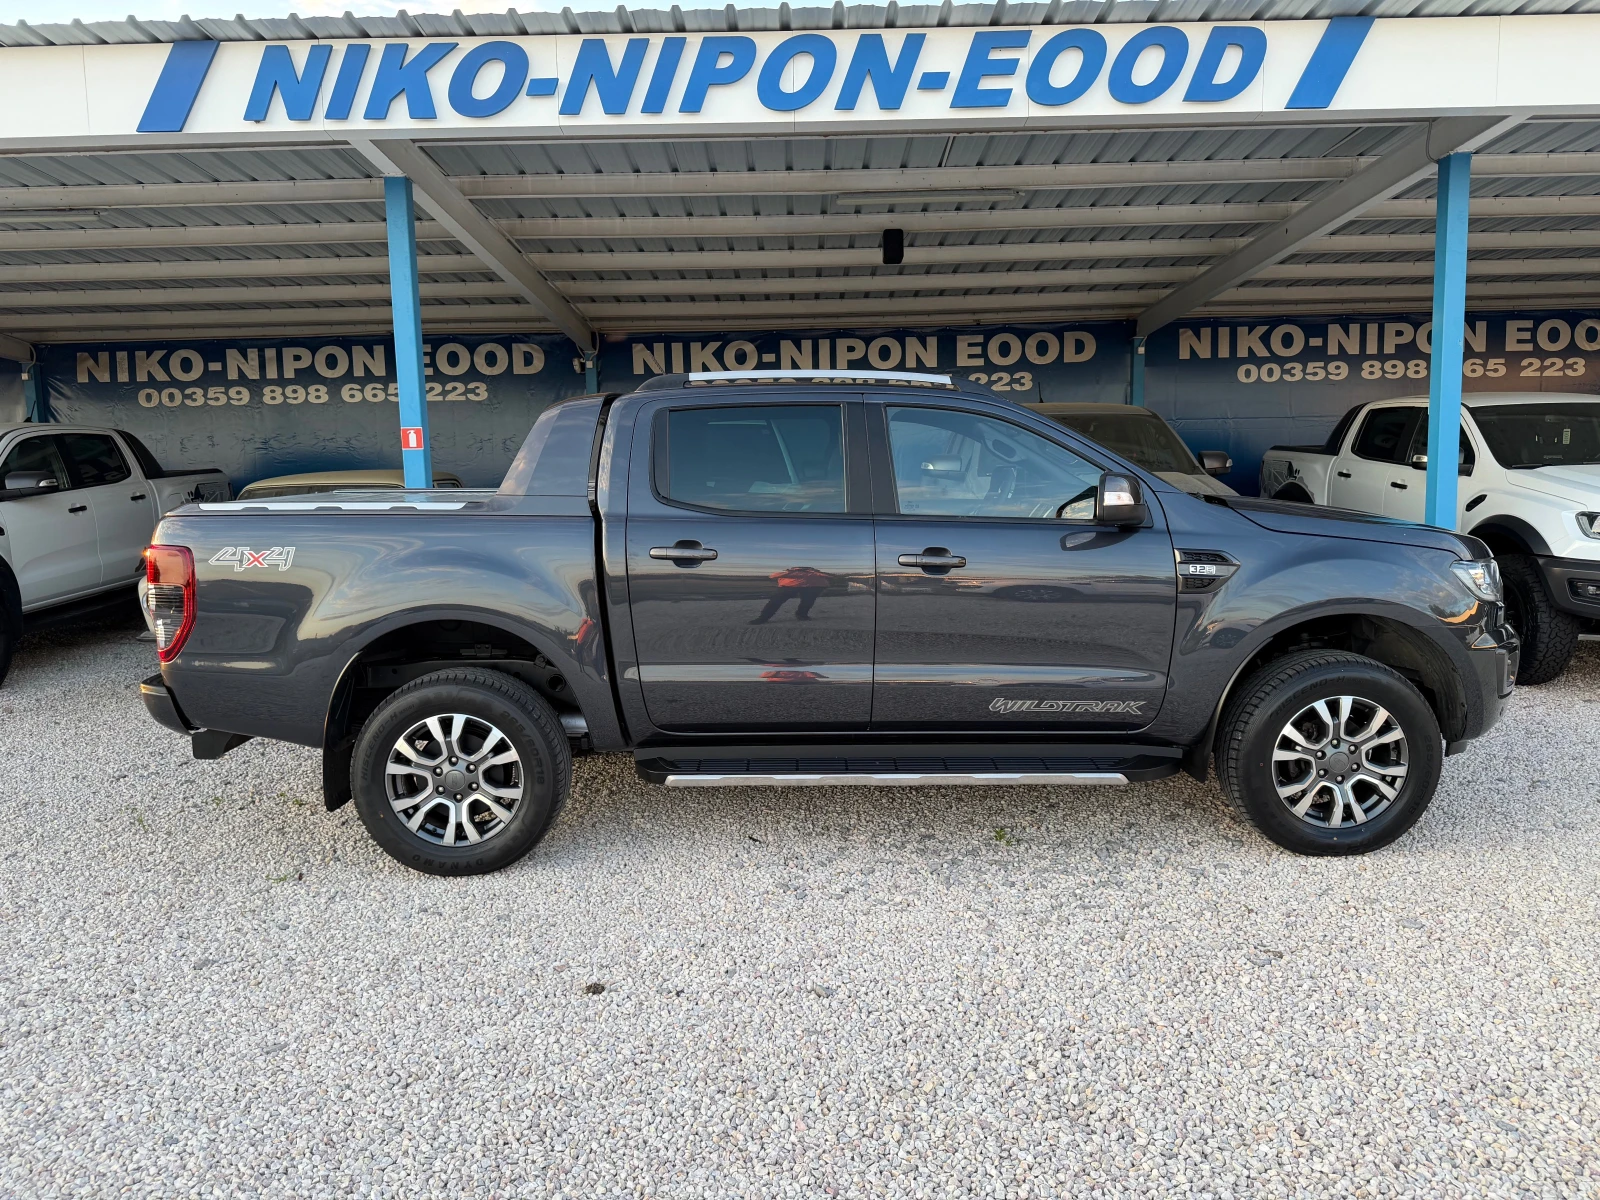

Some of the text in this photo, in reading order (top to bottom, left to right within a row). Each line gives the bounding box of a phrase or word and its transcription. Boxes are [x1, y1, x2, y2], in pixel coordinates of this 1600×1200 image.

[243, 25, 1268, 122] NIKO-NIPON-EOOD
[76, 345, 387, 383] NIKO-NIPON
[632, 331, 1097, 375] NIKO-NIPON EOOD
[1236, 361, 1349, 383] 00359
[1361, 359, 1428, 379] 898
[1520, 357, 1586, 376] 223
[137, 386, 250, 407] 00359
[262, 384, 329, 405] 898
[426, 382, 488, 401] 223
[988, 697, 1147, 715] WILDTRAK
[411, 854, 485, 870] DYNAMO
